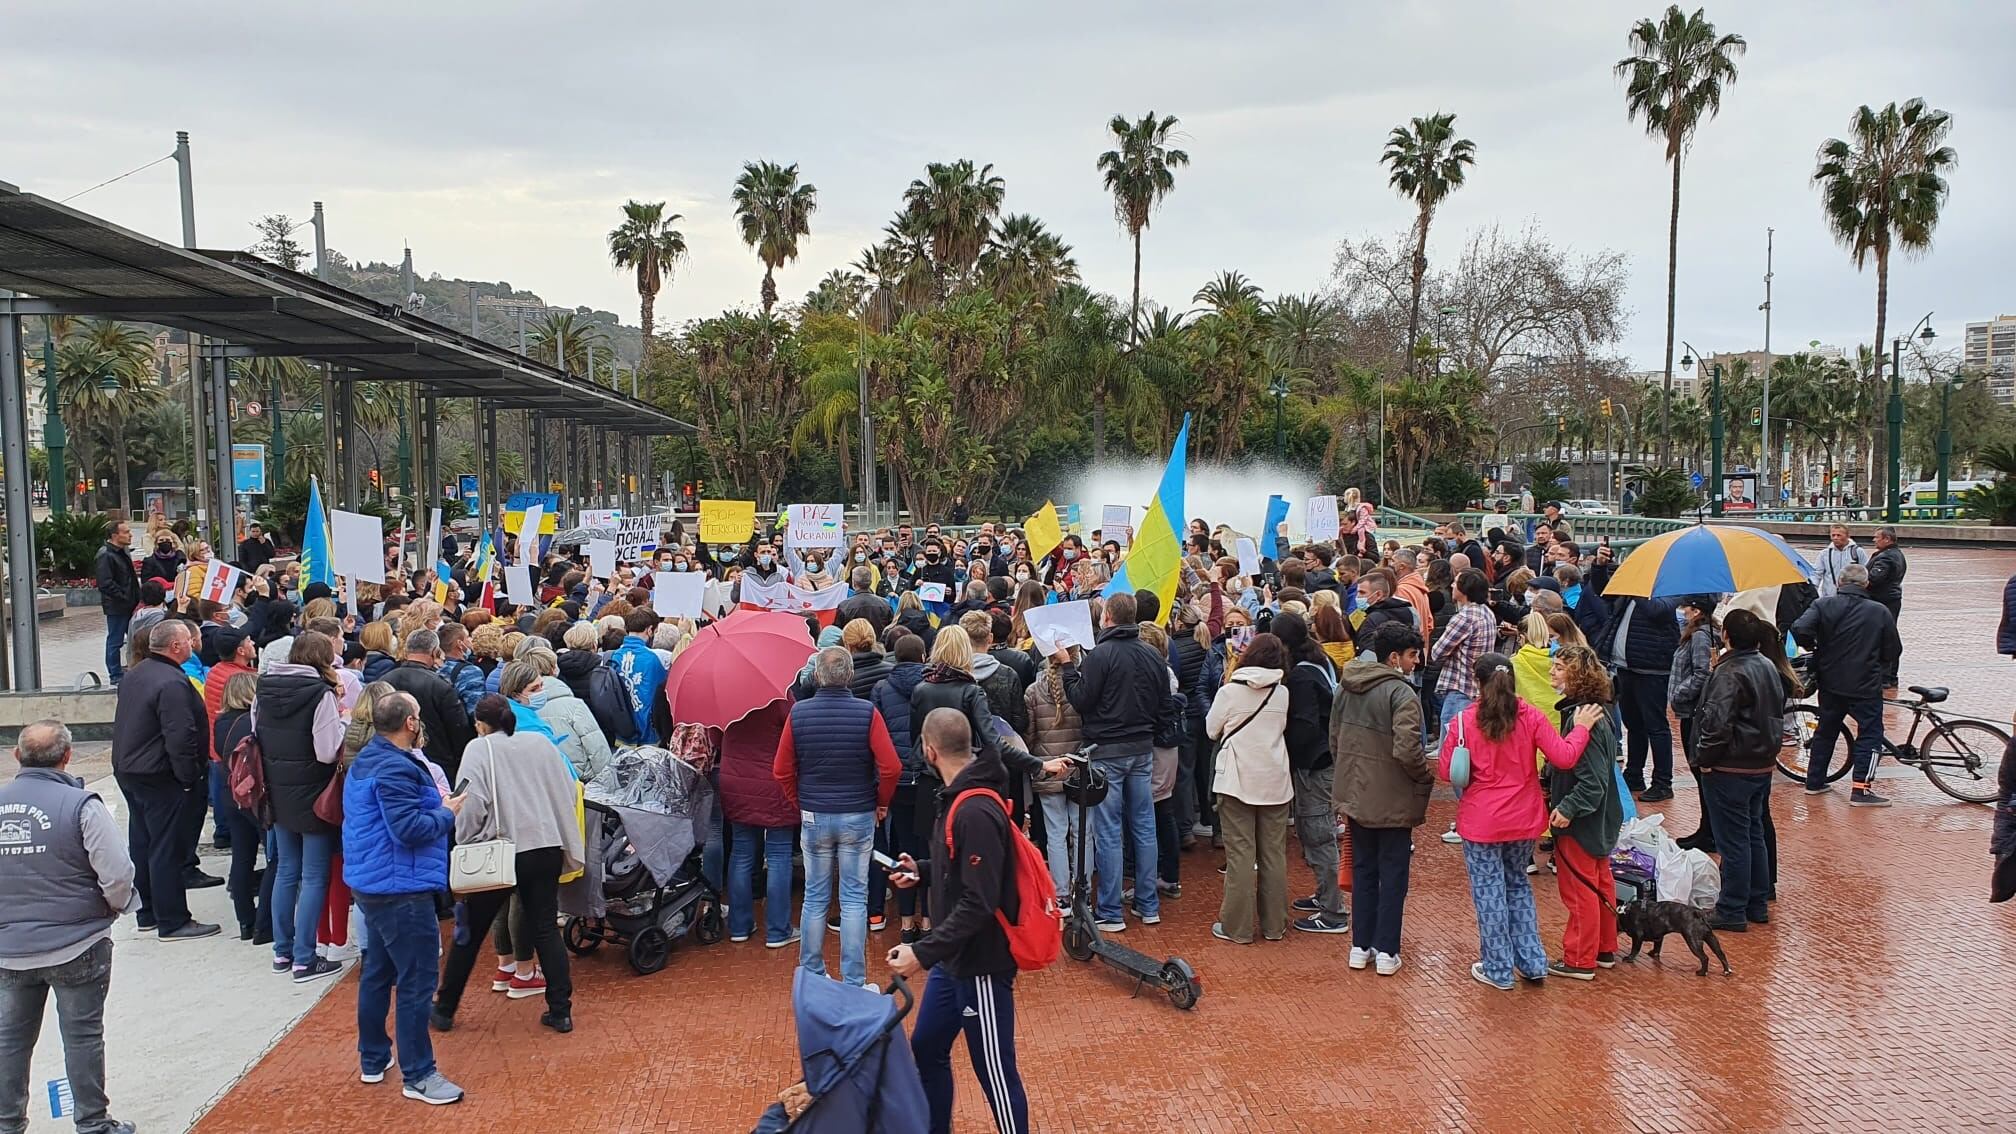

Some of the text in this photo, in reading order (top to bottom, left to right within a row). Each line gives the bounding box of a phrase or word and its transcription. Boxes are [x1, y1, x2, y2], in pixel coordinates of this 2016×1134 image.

[803, 505, 832, 520] PAZ
[616, 530, 654, 546] ПОНАД
[615, 545, 638, 561] УСЕ
[28, 806, 52, 830] PACO
